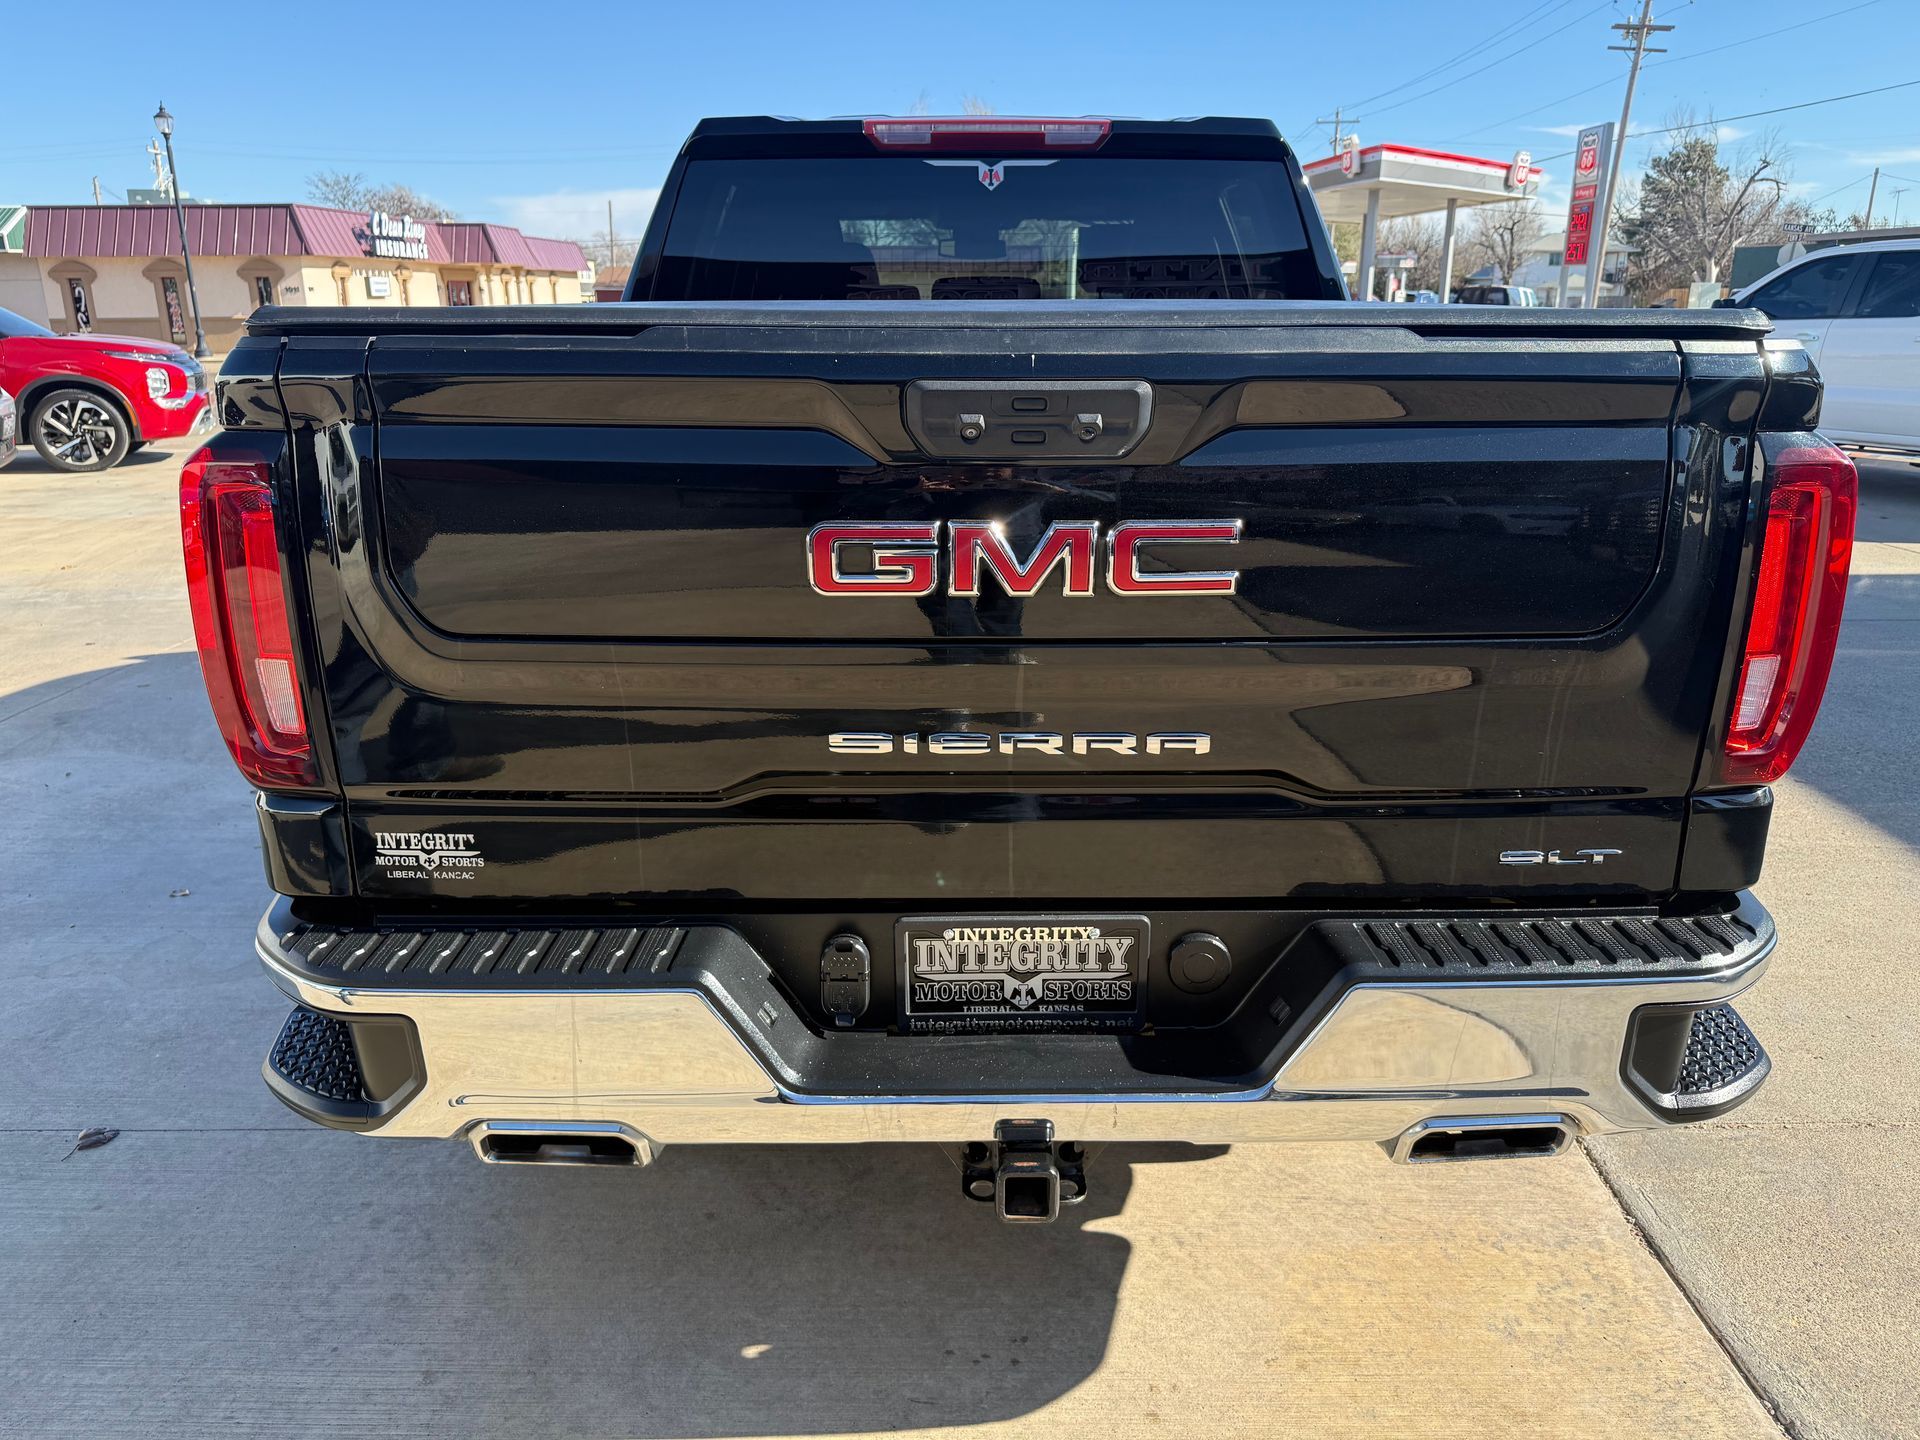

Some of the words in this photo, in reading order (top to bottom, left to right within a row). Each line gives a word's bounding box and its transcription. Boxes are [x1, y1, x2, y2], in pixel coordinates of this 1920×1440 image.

[1581, 150, 1594, 169] 66
[375, 239, 428, 259] INSURANCE
[806, 519, 1242, 598] GMC
[828, 732, 1212, 756] SIERRA
[375, 856, 418, 866] MOTOR
[441, 857, 485, 867] SPORTS
[1499, 849, 1623, 865] SLT
[387, 870, 429, 879] LIBERAL
[952, 927, 1094, 943] INTEGRITY
[913, 936, 1135, 973] INTEGRITY
[915, 982, 1002, 1001] MOTOR
[1044, 981, 1132, 1001] SPORTS
[963, 1004, 1013, 1013] LIBERAL
[1038, 1004, 1085, 1012] KANSAS
